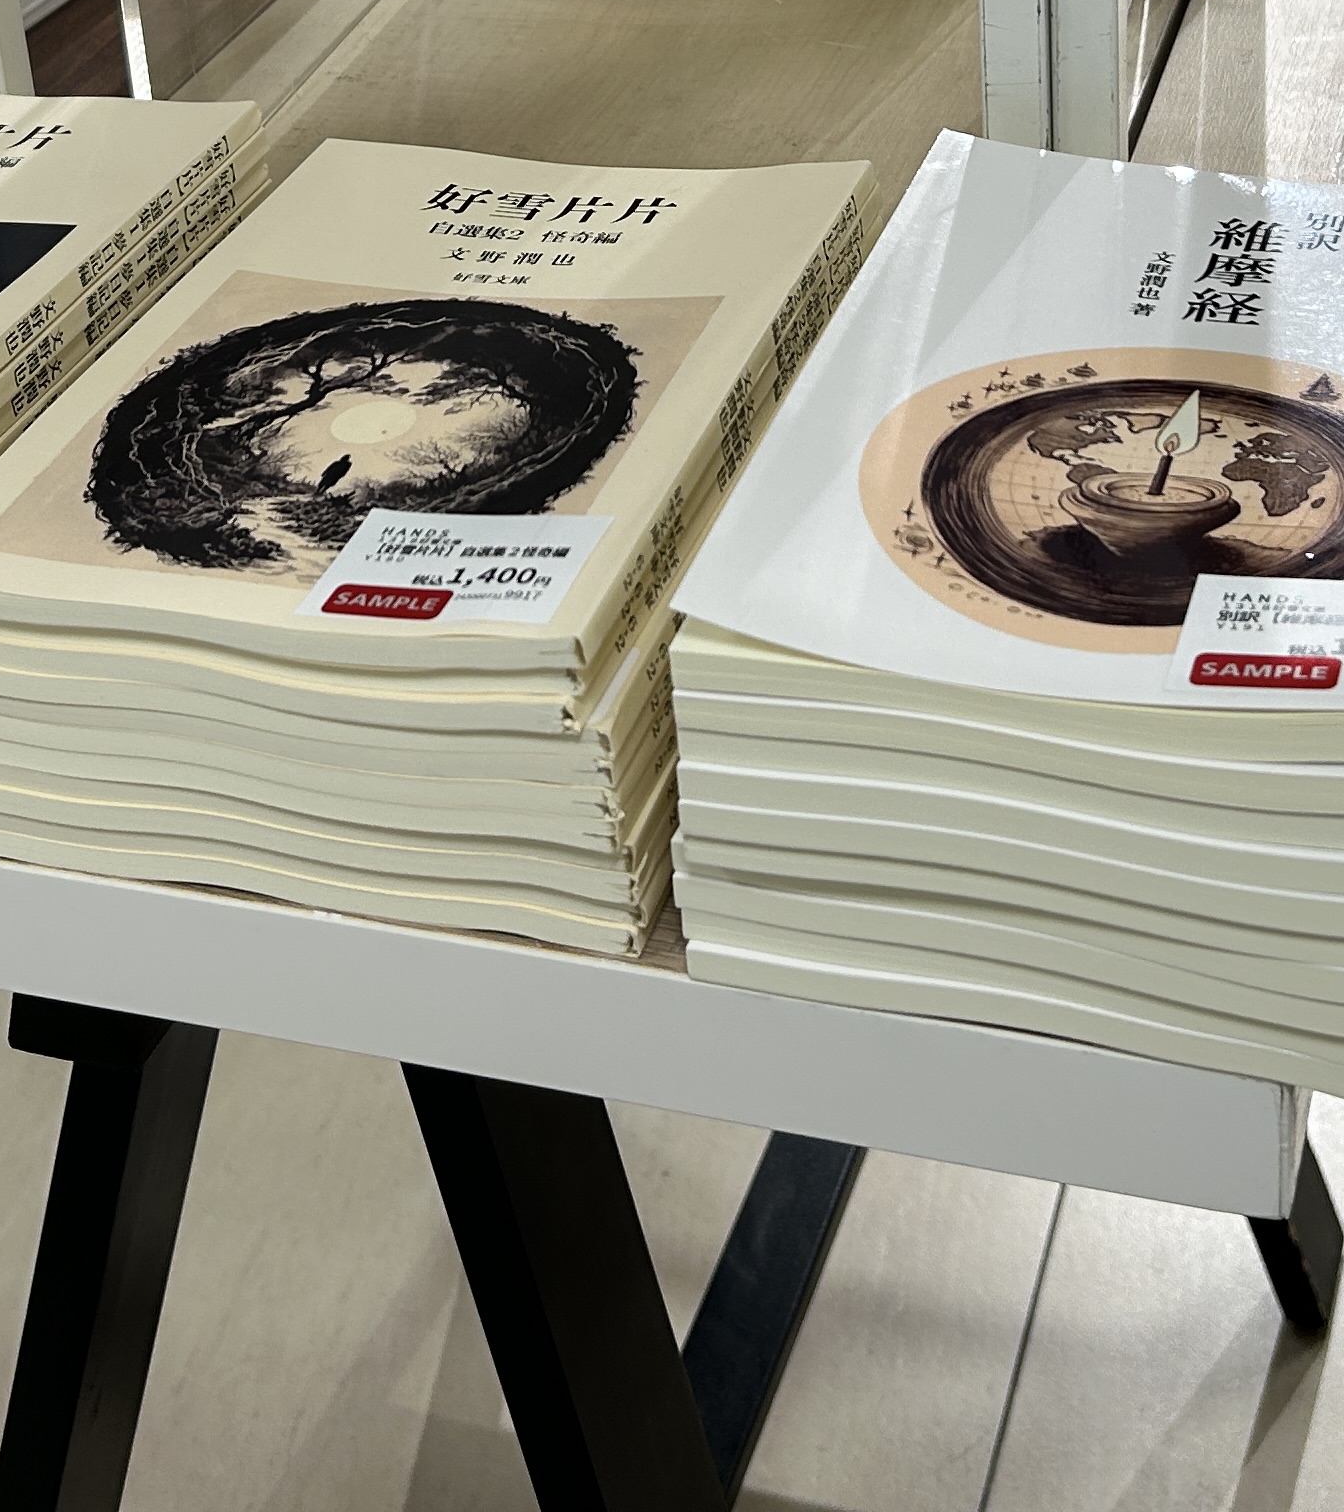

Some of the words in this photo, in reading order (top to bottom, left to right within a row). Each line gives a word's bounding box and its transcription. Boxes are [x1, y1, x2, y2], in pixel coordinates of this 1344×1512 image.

[419, 183, 677, 224] 好雪片片
[541, 230, 623, 244] 怪奇編
[452, 272, 532, 285] 好雪文庫
[1182, 218, 1289, 326] 維摩経
[382, 526, 451, 538] HANDS
[333, 591, 440, 612] SAMPLE
[1223, 592, 1304, 605] HANDS
[1201, 661, 1329, 681] SAMPLE
